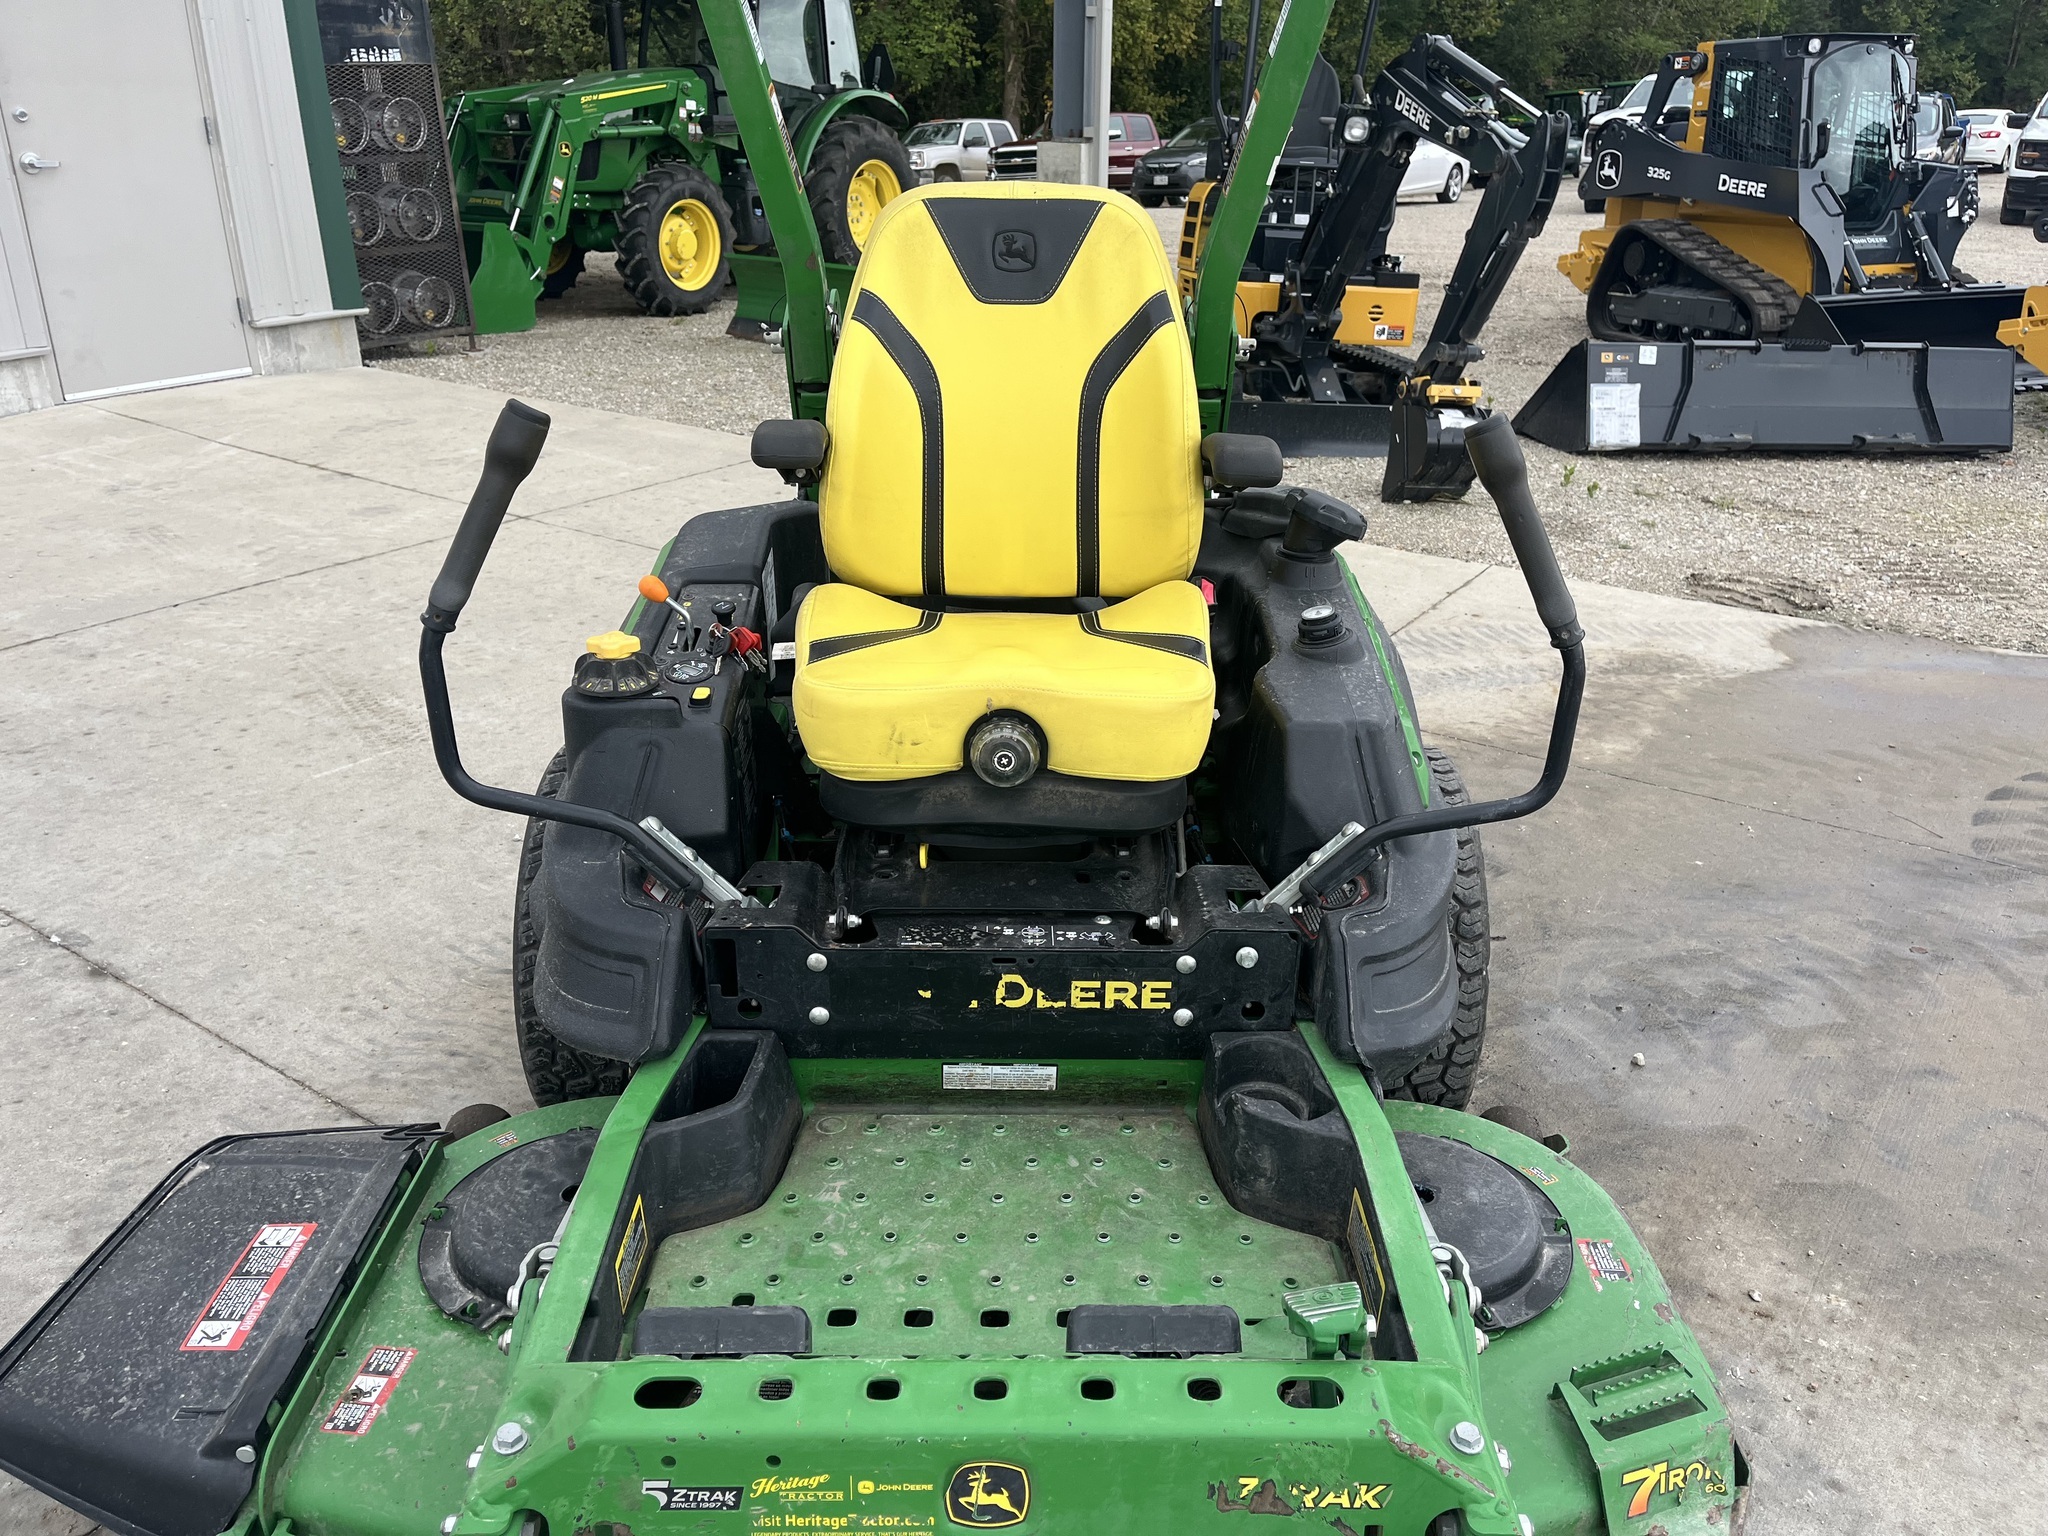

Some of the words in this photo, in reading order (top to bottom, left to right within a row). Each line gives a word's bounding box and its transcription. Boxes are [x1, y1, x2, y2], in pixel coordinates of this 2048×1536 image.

[1394, 89, 1432, 131] DEERE
[1646, 166, 1671, 181] 325G
[1717, 173, 1768, 198] DEERE
[279, 1242, 304, 1269] DANGER
[240, 1300, 266, 1331] PELIGRO
[392, 1356, 412, 1379] DANGER
[357, 1409, 378, 1434] PELIGRO
[672, 1489, 738, 1502] ZTRAK
[750, 1474, 830, 1498] Heritage
[876, 1483, 902, 1491] JOHN
[903, 1483, 934, 1491] DEERE
[1705, 1483, 1726, 1493] 60
